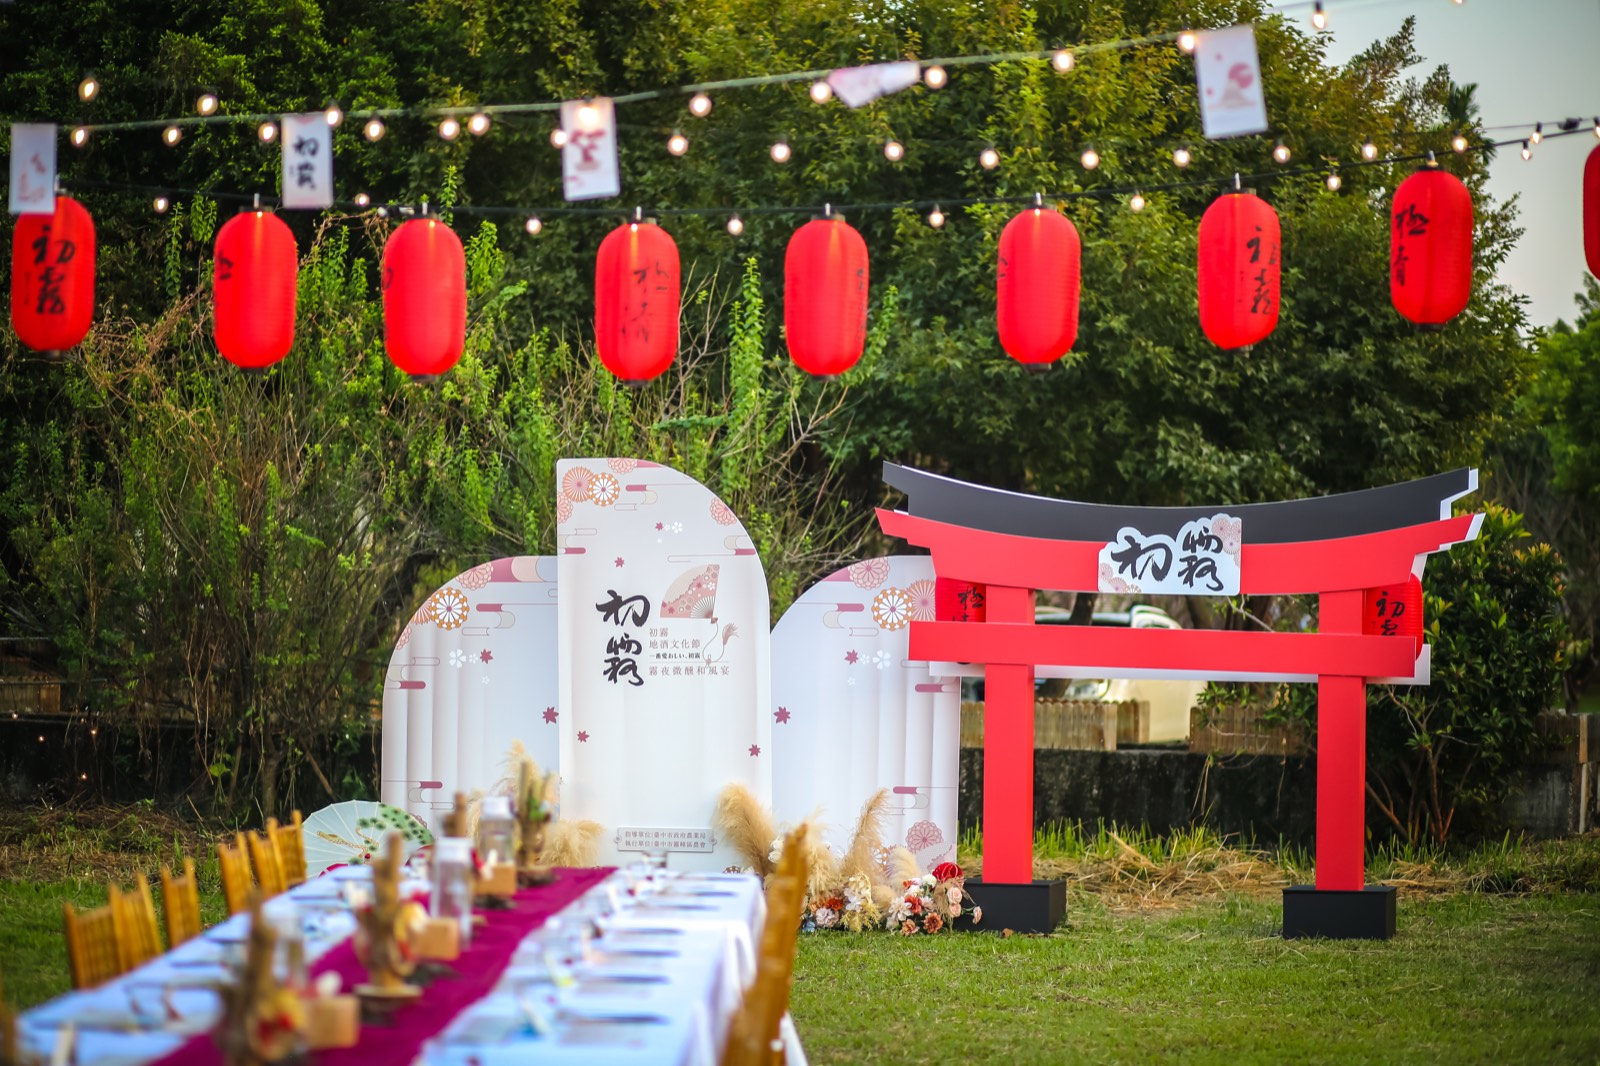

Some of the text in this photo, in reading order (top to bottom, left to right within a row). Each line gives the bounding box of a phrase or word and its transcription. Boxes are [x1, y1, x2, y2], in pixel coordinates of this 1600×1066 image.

[649, 627, 669, 638] 初霧
[649, 639, 701, 650] 地酒文化節
[648, 665, 730, 677] 霧夜微醺和風宴
